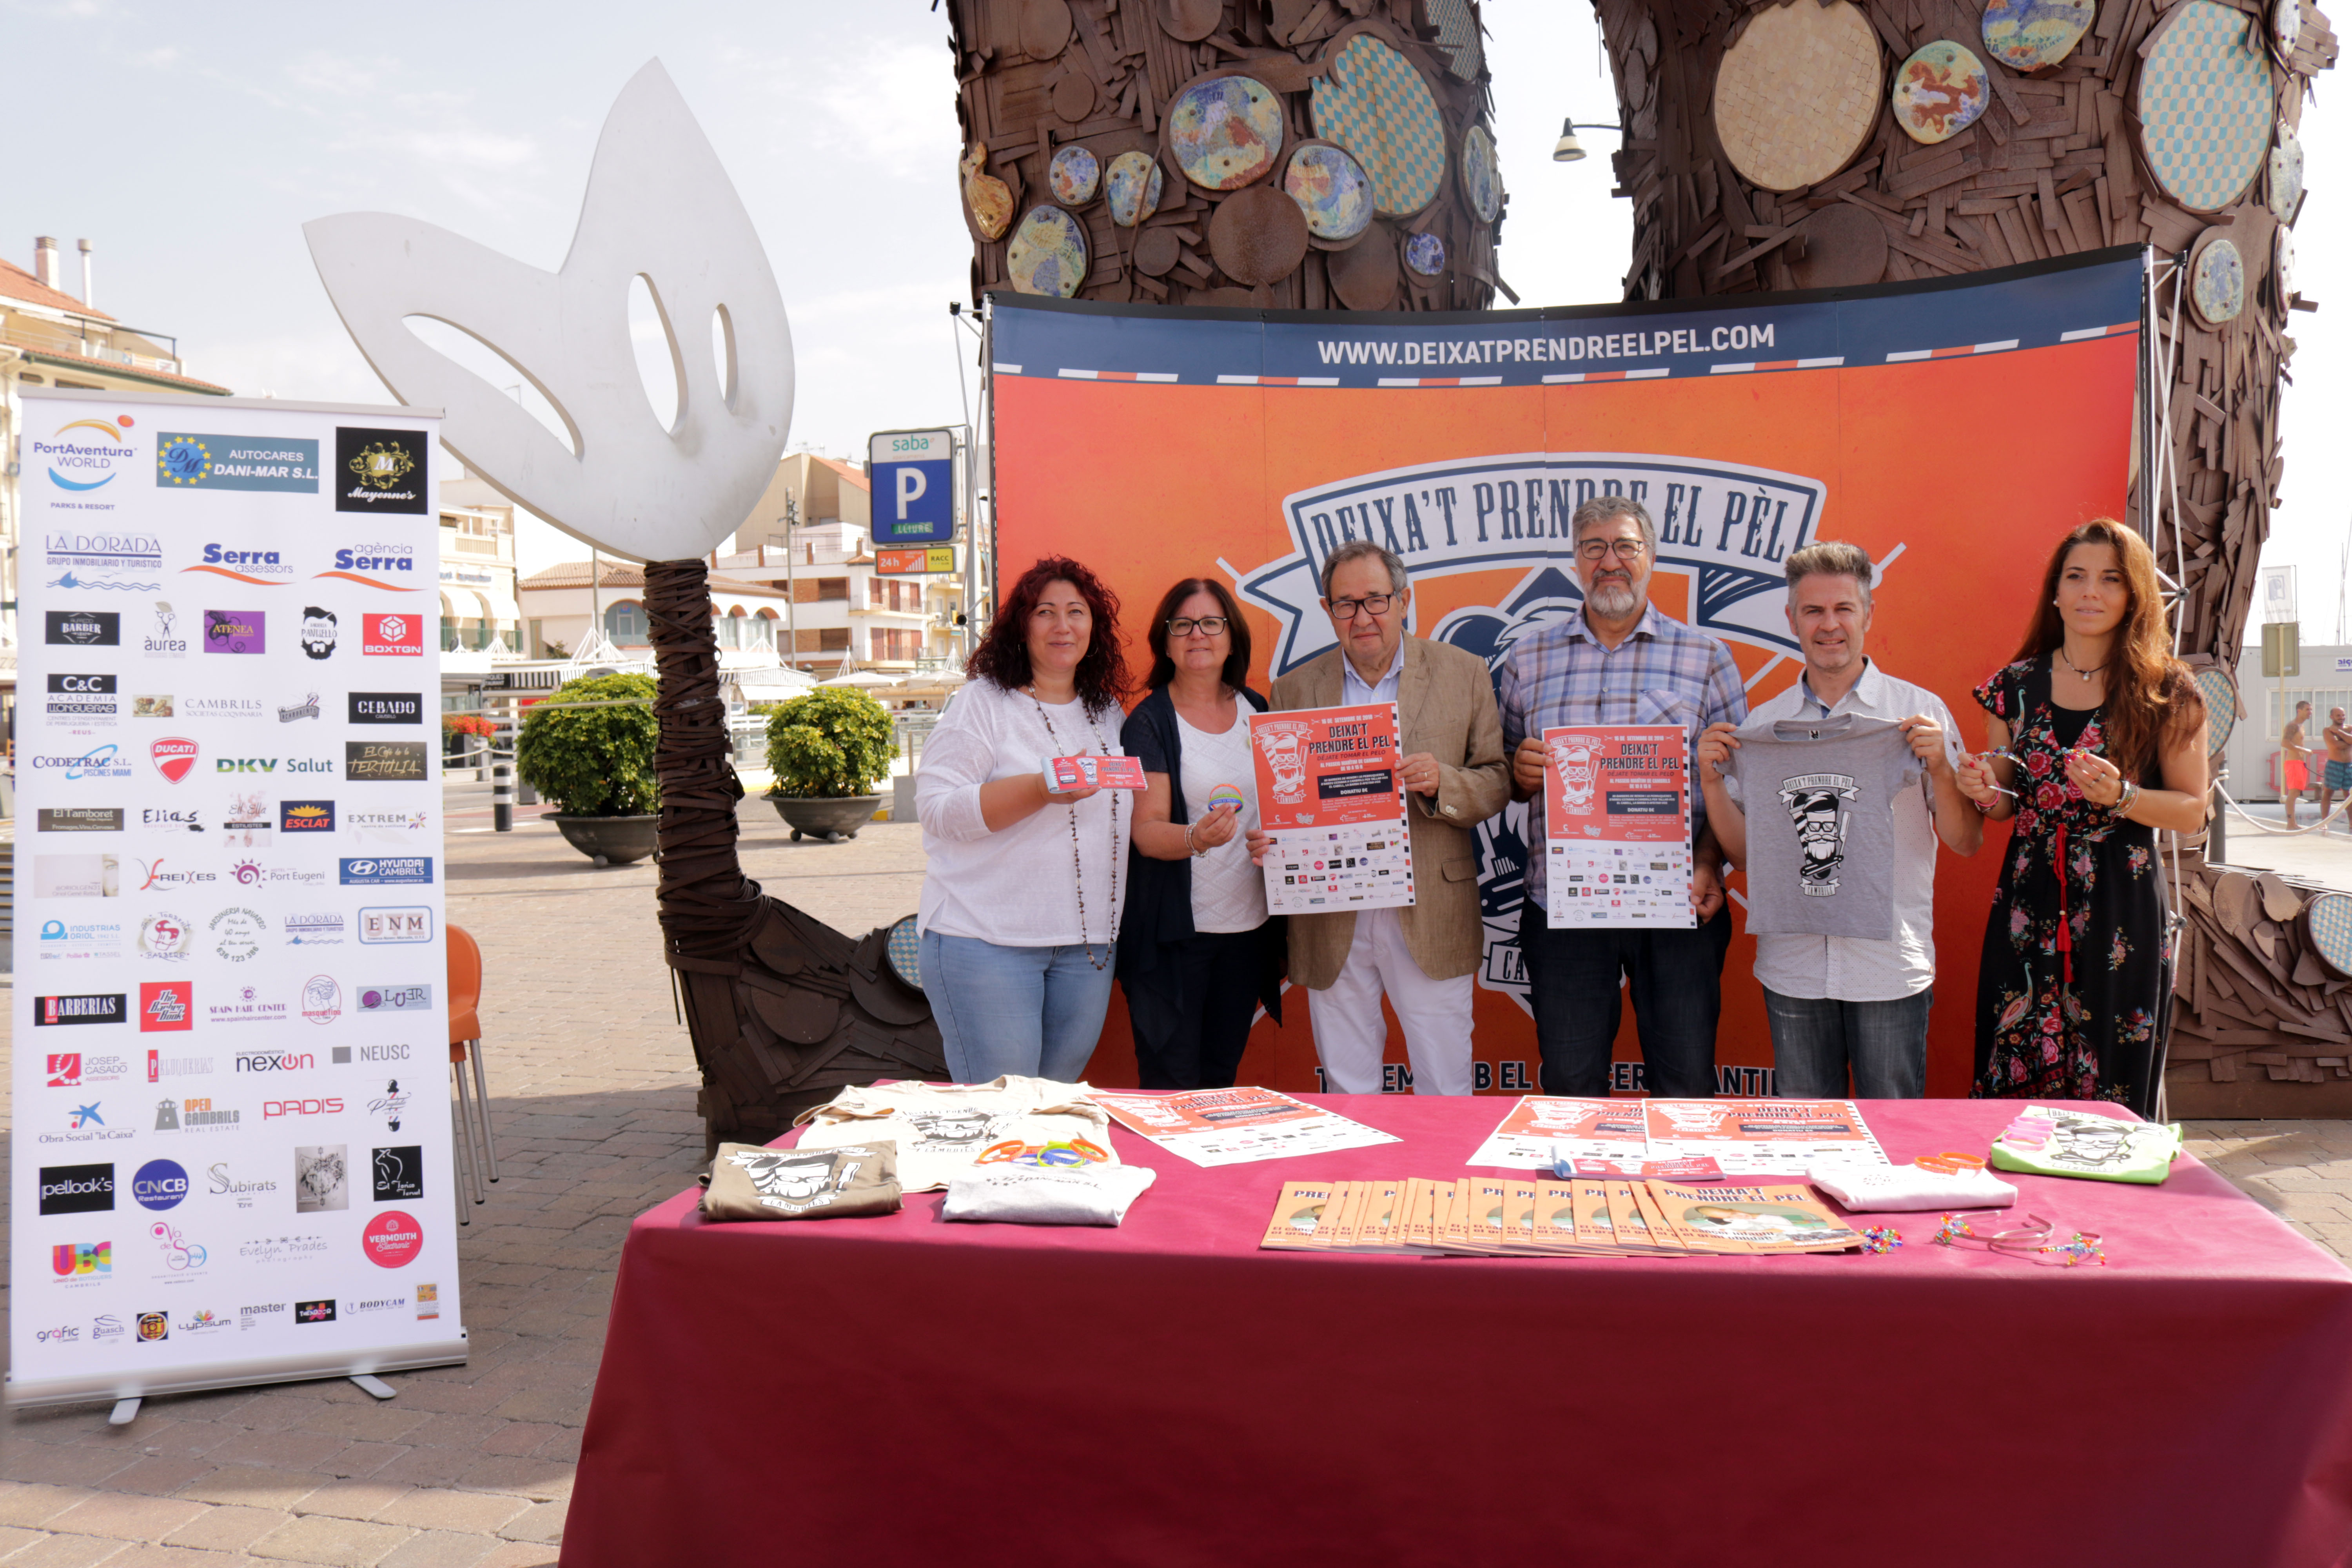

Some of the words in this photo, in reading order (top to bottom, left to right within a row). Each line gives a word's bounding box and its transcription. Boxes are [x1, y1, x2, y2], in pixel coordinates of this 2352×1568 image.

[1318, 324, 1775, 365] WWW.DEIXATPRENDREELPEL.COM
[893, 435, 929, 451] saba
[34, 443, 133, 457] PortAventura
[229, 450, 304, 462] AUTOCARES
[57, 457, 110, 468] WORLD
[214, 464, 289, 477] DANI-MAR
[292, 468, 318, 479] S.L.
[348, 487, 416, 502] Mayenne's
[897, 468, 927, 519] P
[898, 524, 929, 534] LLIURE
[1660, 483, 1702, 547] EL
[1716, 486, 1788, 563] PÈL
[46, 535, 68, 550] LA
[76, 535, 162, 553] DORADA
[355, 543, 412, 555] agència
[203, 543, 279, 564] Serra
[73, 558, 119, 567] INMOBILIARIO
[334, 549, 412, 571] Serra
[235, 564, 293, 573] assessors
[62, 623, 101, 634] BARBER
[213, 624, 254, 634] ATENEA
[144, 637, 186, 651] àurea
[365, 645, 421, 653] BOXTGN
[62, 676, 102, 691] C&C
[49, 704, 115, 713] LLONGUERAS
[185, 699, 261, 709] CAMBRILS
[358, 701, 415, 714] CEBADO
[1329, 723, 1368, 739] DEIXA'T
[155, 745, 194, 753] DUCATI
[1309, 739, 1355, 755] PRENDRE
[1358, 737, 1370, 750] EL
[1372, 735, 1391, 749] PEL
[1621, 744, 1659, 756] DEIXA'T
[33, 756, 111, 768] CODETRAC
[216, 759, 278, 773] DKV
[287, 758, 333, 773] Salut
[347, 759, 422, 774] TERTULIA
[1601, 758, 1645, 770] PRENDRE
[1648, 758, 1659, 770] EL
[1662, 758, 1680, 770] PEL
[1807, 776, 1831, 786] PRENDRE
[1834, 776, 1839, 785] EL
[53, 809, 63, 817] El
[64, 809, 113, 818] Tamboret
[247, 802, 267, 814] Ella
[143, 809, 198, 822] Elias
[348, 814, 406, 823] EXTREM
[285, 818, 330, 829] ESCLAT
[379, 859, 424, 867] HYUNDAI
[270, 872, 290, 880] Port
[292, 871, 325, 881] Eugeni
[379, 867, 425, 876] CAMBRILS
[209, 907, 240, 931] JARDINERIA
[242, 907, 266, 930] NAVARRO
[285, 915, 298, 925] LA
[300, 914, 344, 924] DORADA
[216, 947, 229, 959] 636
[246, 946, 259, 959] 386
[48, 998, 116, 1017] BARBERIAS
[360, 1045, 410, 1062] NEUSC
[85, 1056, 120, 1066] JOSEP
[85, 1065, 127, 1074] CASADO
[1499, 1061, 1532, 1090] EL
[185, 1098, 211, 1112] OPEN
[263, 1098, 344, 1120] PADIS
[185, 1110, 240, 1125] CAMBRILS
[39, 1135, 64, 1143] Obra
[66, 1132, 93, 1142] Social
[134, 1178, 187, 1194] CNCB
[376, 1181, 390, 1191] El
[1697, 1188, 1764, 1196] DEIXA'T
[138, 1194, 184, 1202] Restaurant
[1664, 1189, 1747, 1203] PRENDRE
[1777, 1194, 1810, 1202] PÈL
[369, 1232, 417, 1243] VERMOUTH
[240, 1246, 282, 1259] Evelyn
[289, 1242, 327, 1253] Prades
[376, 1241, 410, 1252] Electronic
[53, 1241, 112, 1276] UBC
[256, 1256, 313, 1264] photography
[241, 1303, 286, 1314] master
[360, 1298, 405, 1308] BODYCAM
[93, 1325, 124, 1339] guasch
